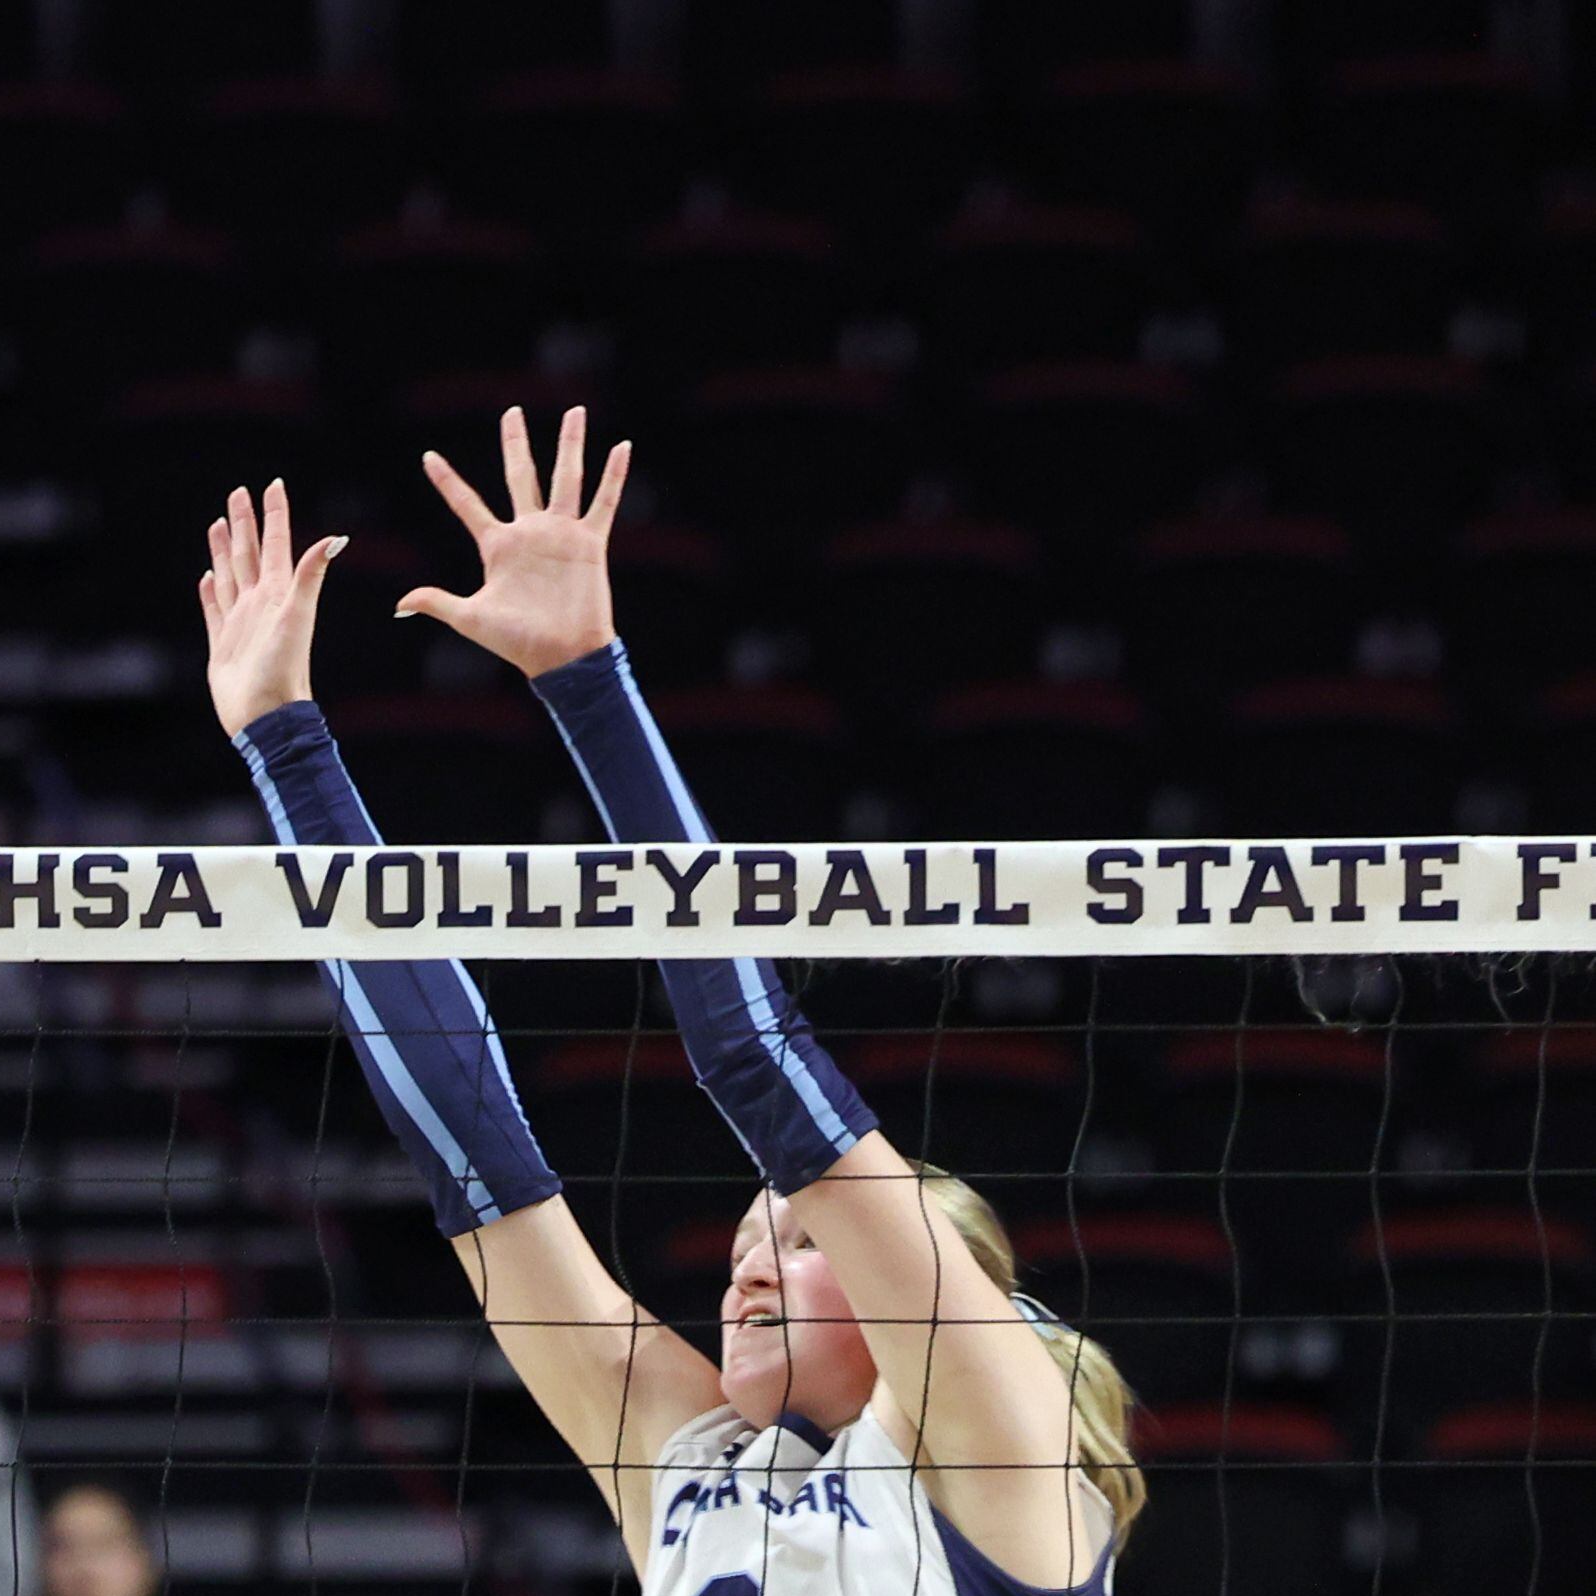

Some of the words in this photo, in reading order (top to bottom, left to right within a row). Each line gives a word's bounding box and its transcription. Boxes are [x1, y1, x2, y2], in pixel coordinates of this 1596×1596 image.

[275, 849, 1030, 929] VOLLEYBALL
[1087, 844, 1460, 925] STATE
[1517, 843, 1596, 921] F
